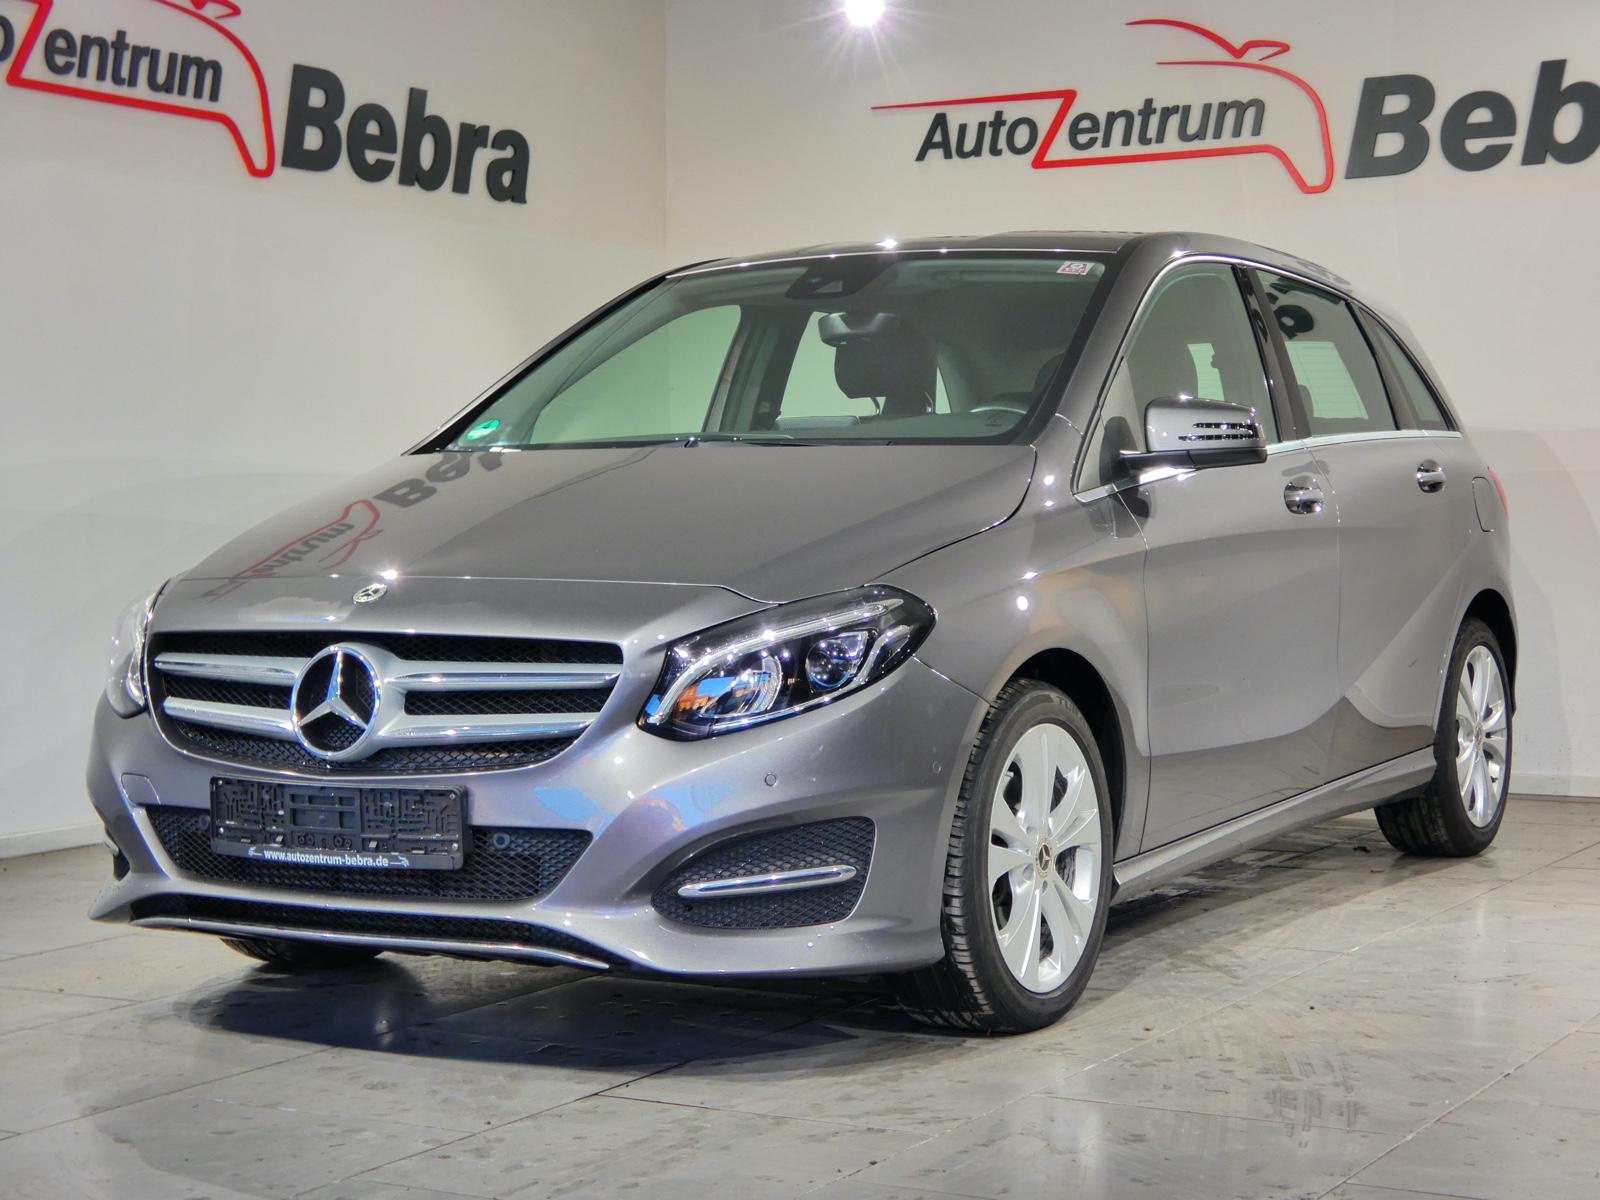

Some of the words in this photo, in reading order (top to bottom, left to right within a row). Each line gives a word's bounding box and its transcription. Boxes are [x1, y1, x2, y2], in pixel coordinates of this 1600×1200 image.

[281, 63, 530, 204] Bebra
[1344, 59, 1600, 180] Beb
[263, 849, 389, 867] www.autozentrum-bebra.de
